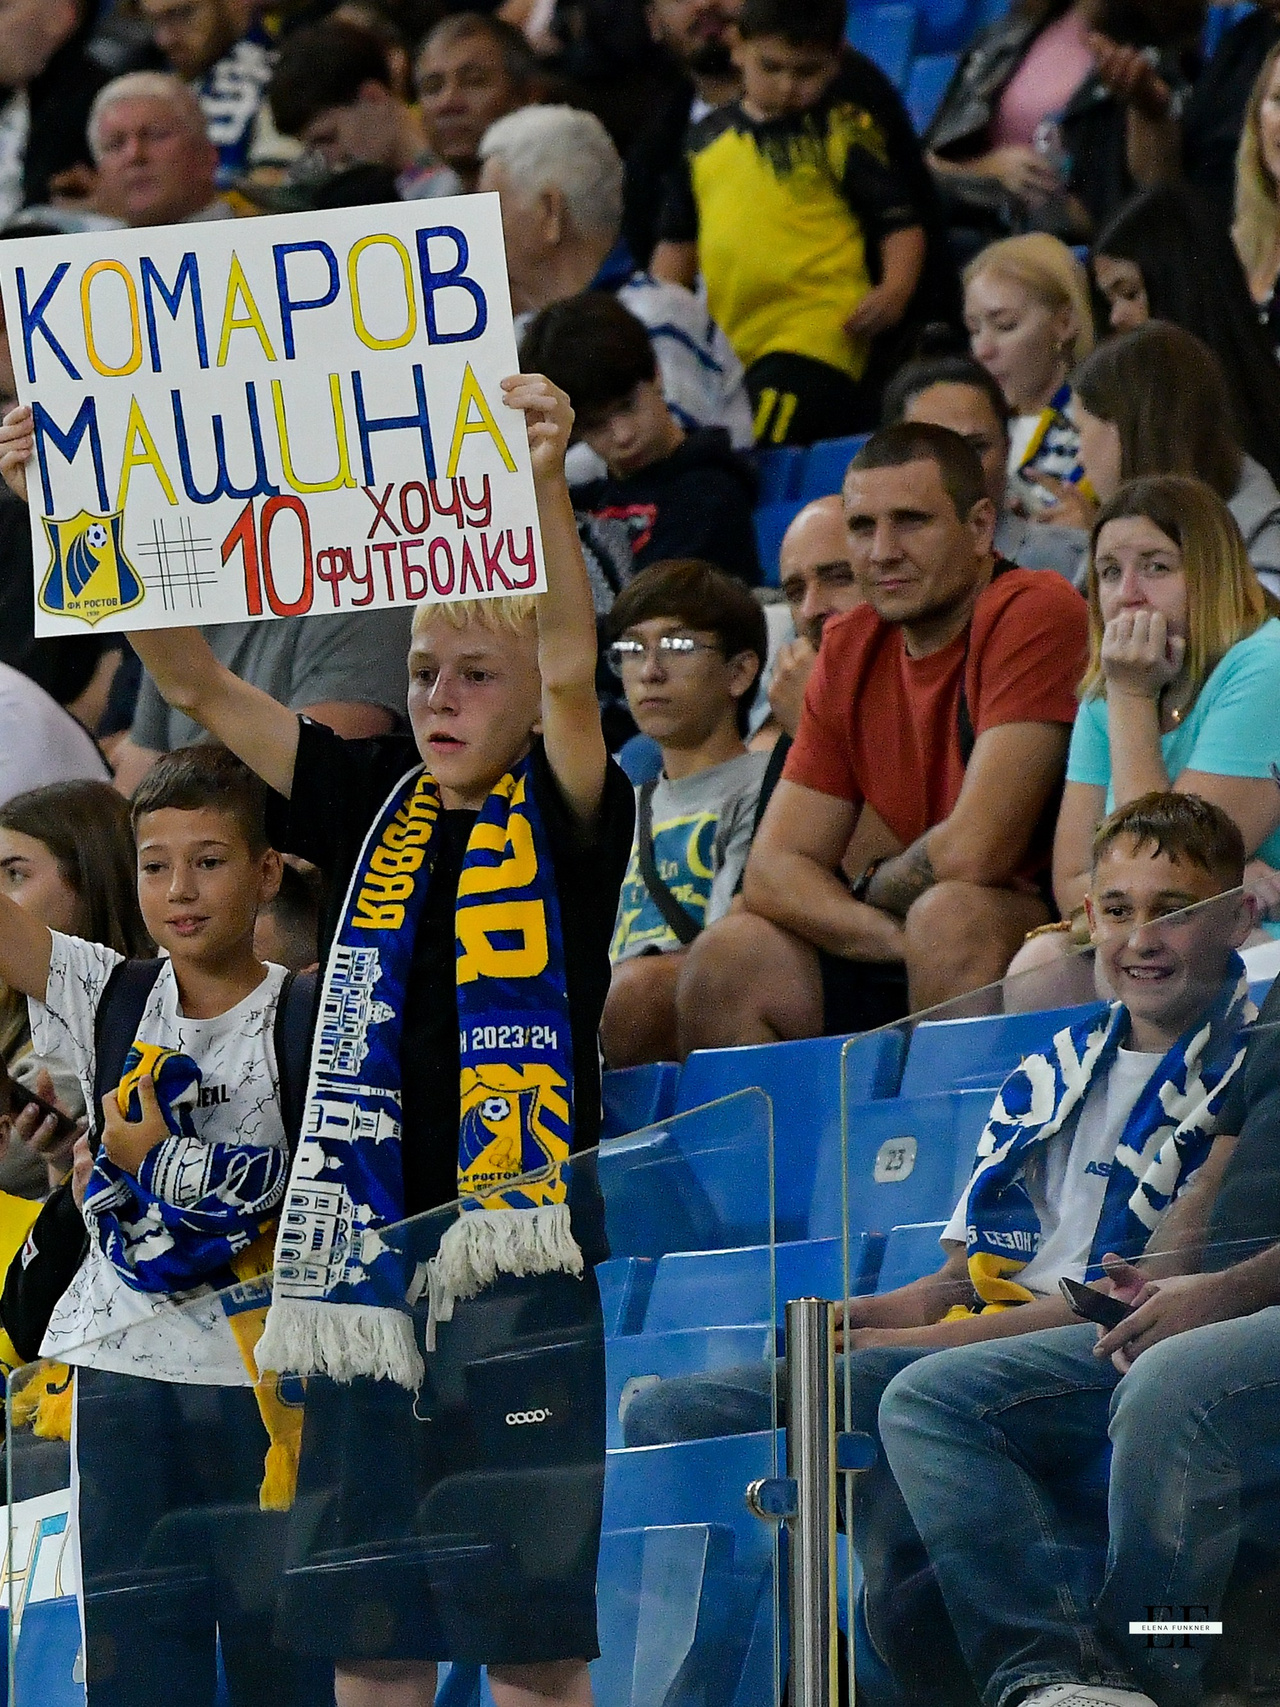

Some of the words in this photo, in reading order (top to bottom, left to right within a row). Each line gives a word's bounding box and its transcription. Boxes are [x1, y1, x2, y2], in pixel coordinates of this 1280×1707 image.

[15, 226, 488, 383] КОМАРОВ
[32, 361, 518, 516] МАШИНА
[360, 473, 493, 539] ХОЧУ
[317, 526, 537, 607] ФУТБОЛКУ
[66, 602, 82, 610] ФК
[83, 597, 118, 608] РОСТОВ
[471, 1025, 558, 1050] 2023/24
[886, 1149, 906, 1170] 23
[982, 1230, 1032, 1253] СЕЗОН
